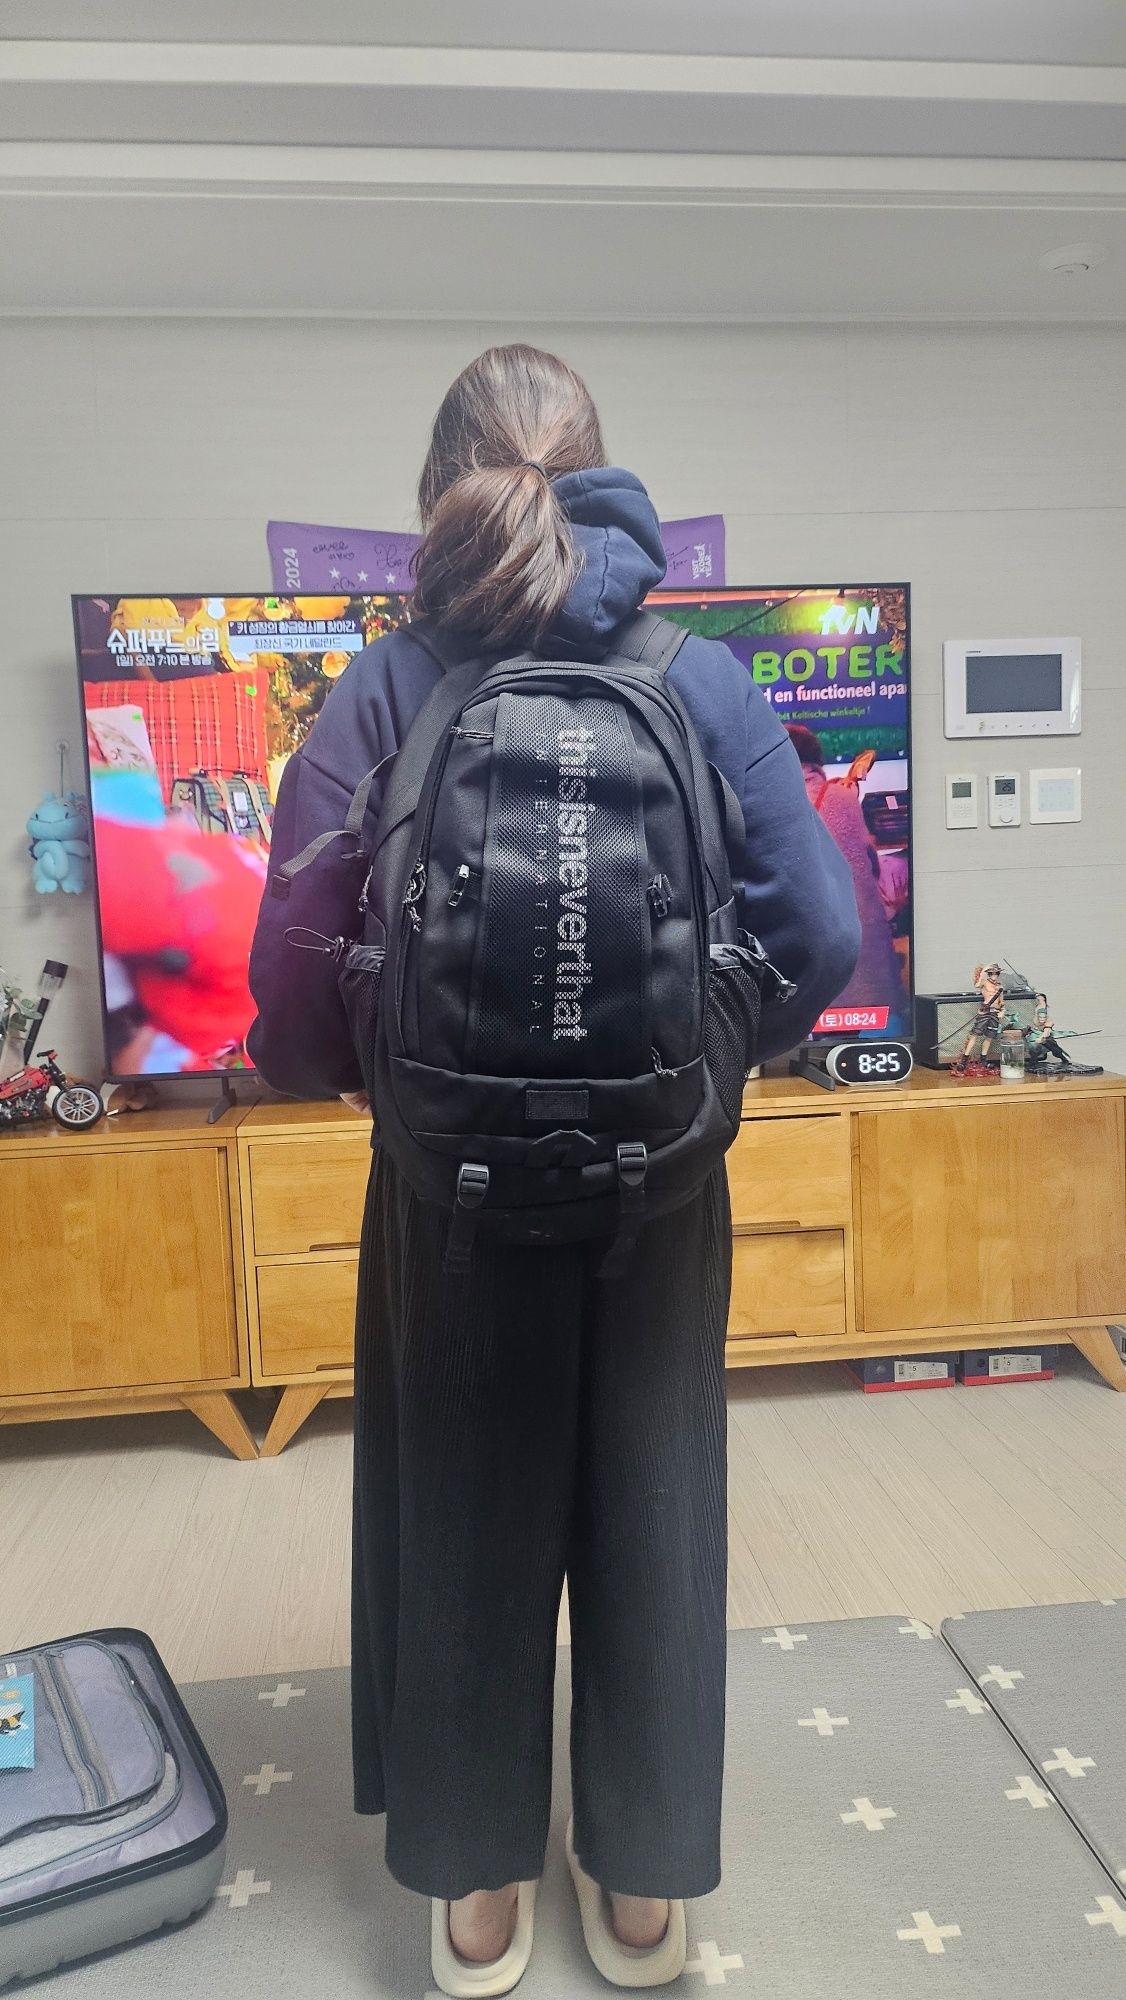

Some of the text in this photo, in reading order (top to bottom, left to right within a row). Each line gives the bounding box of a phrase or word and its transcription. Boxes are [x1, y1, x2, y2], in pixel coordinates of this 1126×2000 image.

[283, 547, 300, 588] 2024
[704, 554, 712, 578] YEAR
[236, 621, 247, 634] 키
[157, 654, 178, 666] 7:10
[752, 643, 903, 685] BOTER
[775, 691, 793, 703] en
[796, 681, 876, 702] functioneel
[553, 727, 598, 1041] thisisneverthat
[820, 1012, 877, 1027] (토) 08:24
[858, 1052, 901, 1074] 8:25
